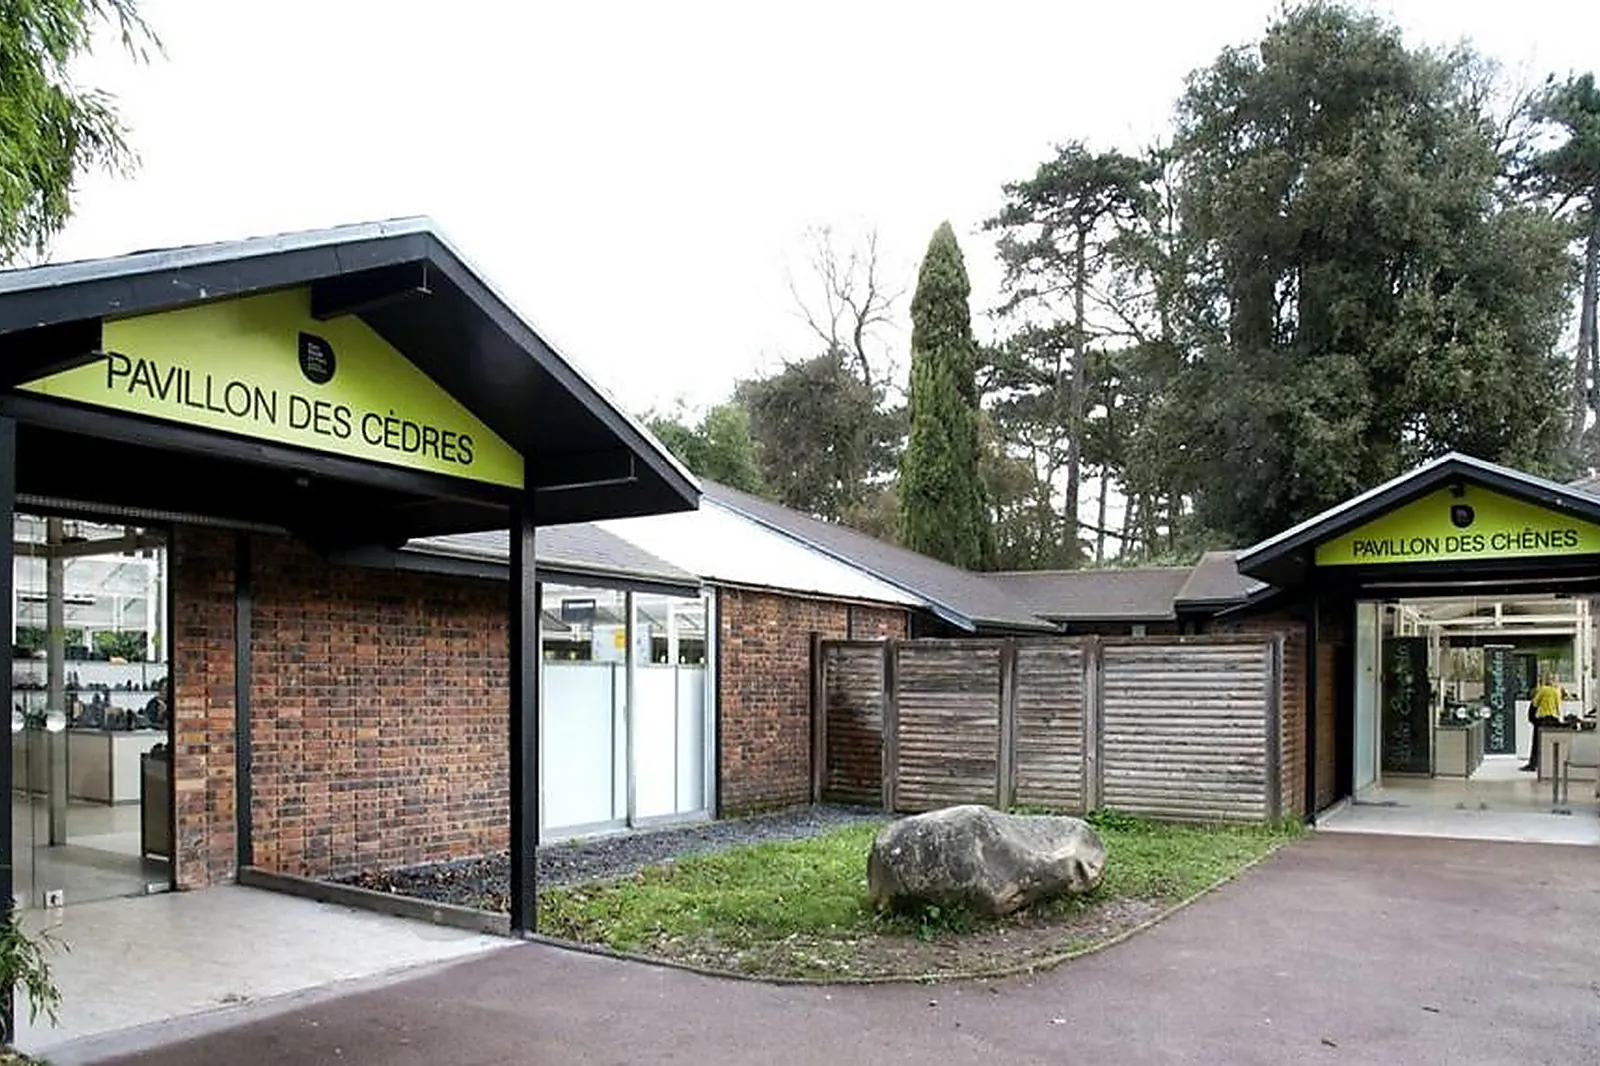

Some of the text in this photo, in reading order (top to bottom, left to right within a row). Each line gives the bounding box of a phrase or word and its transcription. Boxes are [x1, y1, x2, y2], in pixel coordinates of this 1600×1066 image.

[106, 352, 277, 425] PAVILLON
[289, 394, 352, 439] DES
[361, 408, 474, 465] CÈDRES
[1353, 527, 1578, 557] PAVILLON DES CHÊNES
